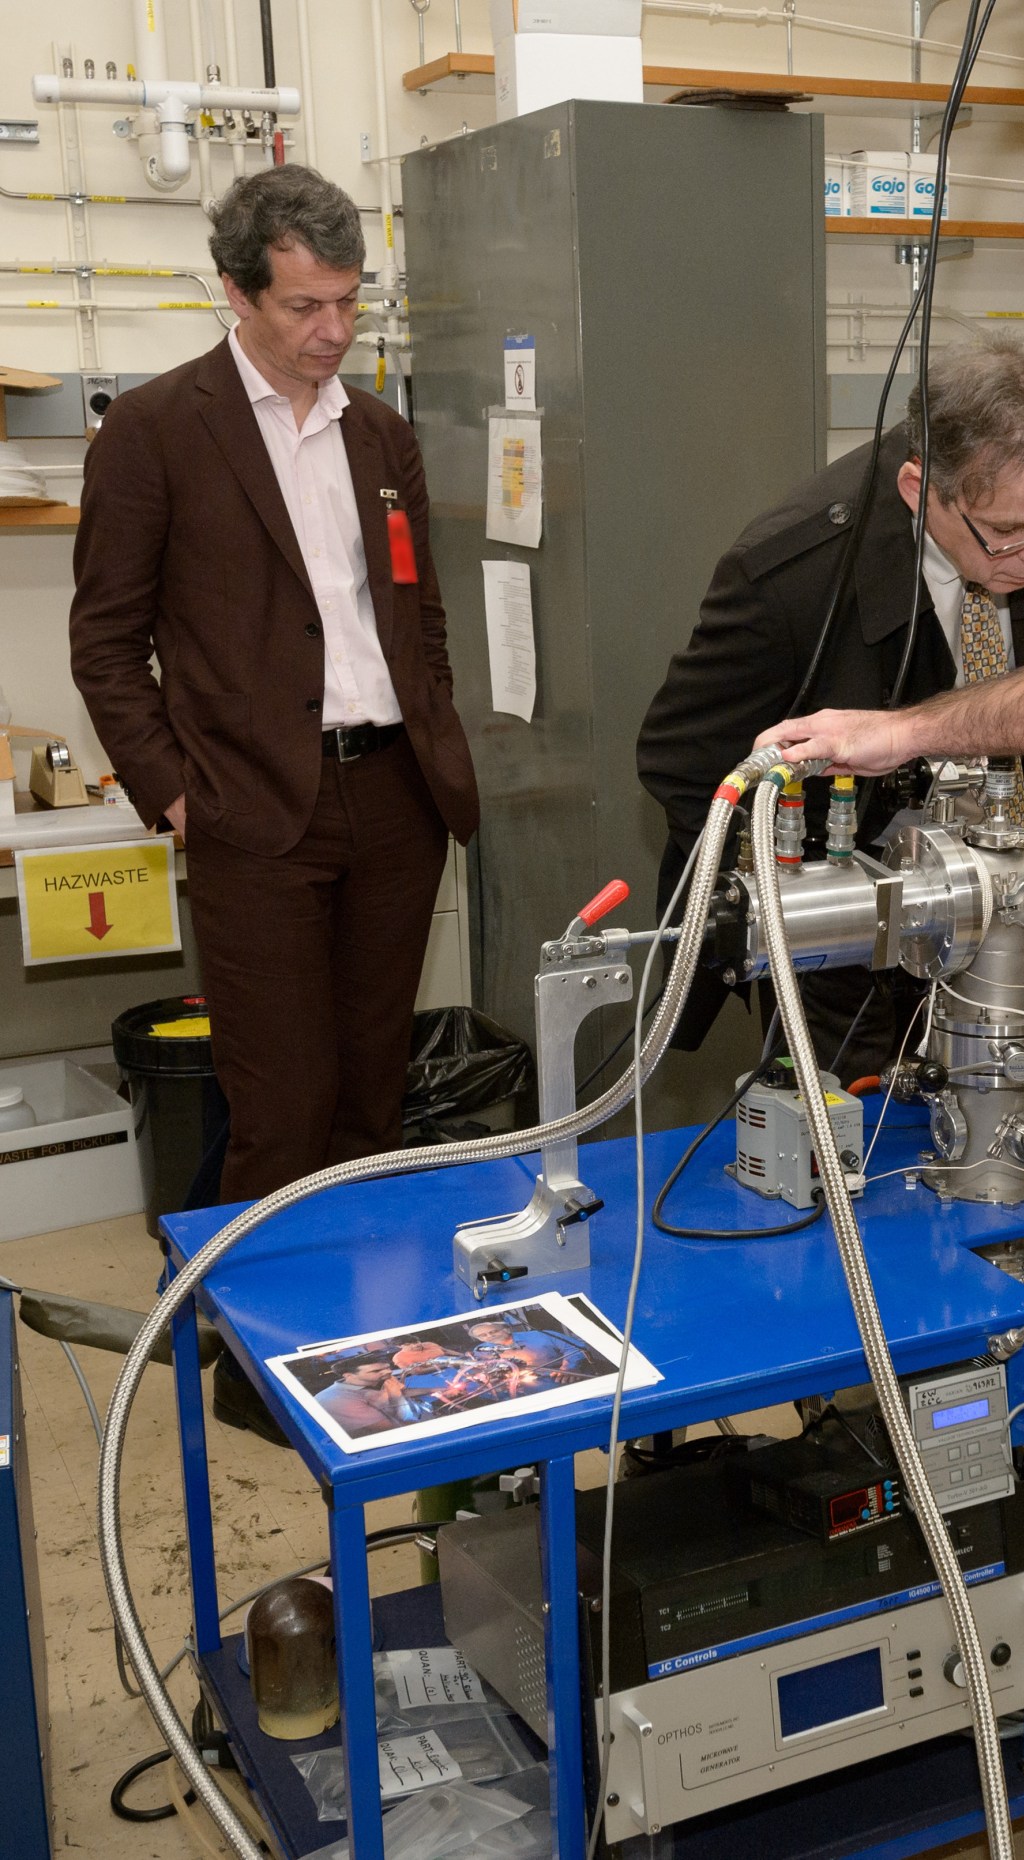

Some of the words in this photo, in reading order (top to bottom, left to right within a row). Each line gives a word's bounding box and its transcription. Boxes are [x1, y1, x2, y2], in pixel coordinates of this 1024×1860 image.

[44, 867, 149, 893] HAZWASTE
[41, 1143, 66, 1156] FOR
[964, 1568, 995, 1581] Controller
[659, 1607, 670, 1616] TC1
[660, 1623, 672, 1632] TC2
[658, 1661, 673, 1674] JC
[674, 1649, 718, 1669] Controls
[657, 1722, 703, 1746] OPTHOS
[700, 1744, 740, 1762] MICROWAVE
[699, 1756, 741, 1774] GENERATOR
